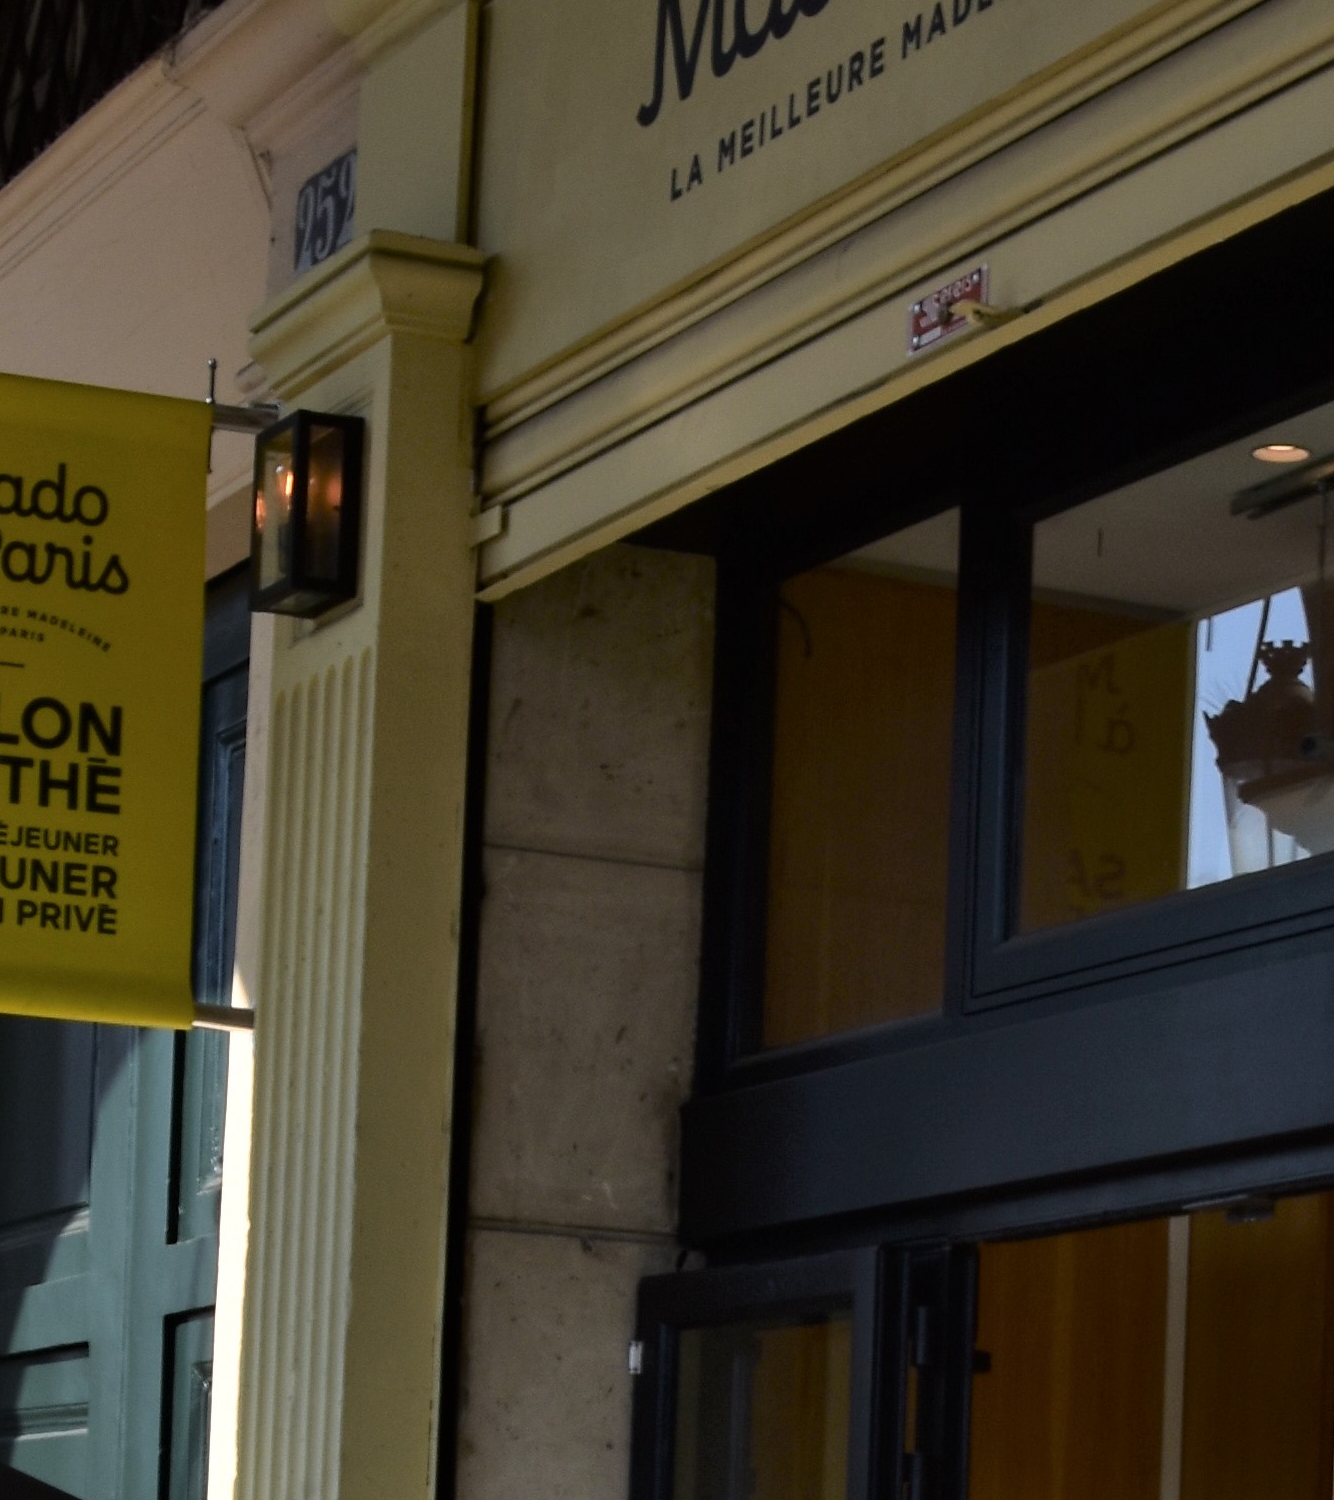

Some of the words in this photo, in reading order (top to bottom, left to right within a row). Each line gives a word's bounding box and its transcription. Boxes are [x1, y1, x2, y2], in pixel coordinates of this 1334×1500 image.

[670, 156, 703, 202] LA
[717, 39, 887, 174] MEILLEURE
[0, 625, 45, 643] PARIS
[26, 610, 111, 652] MADELEINE
